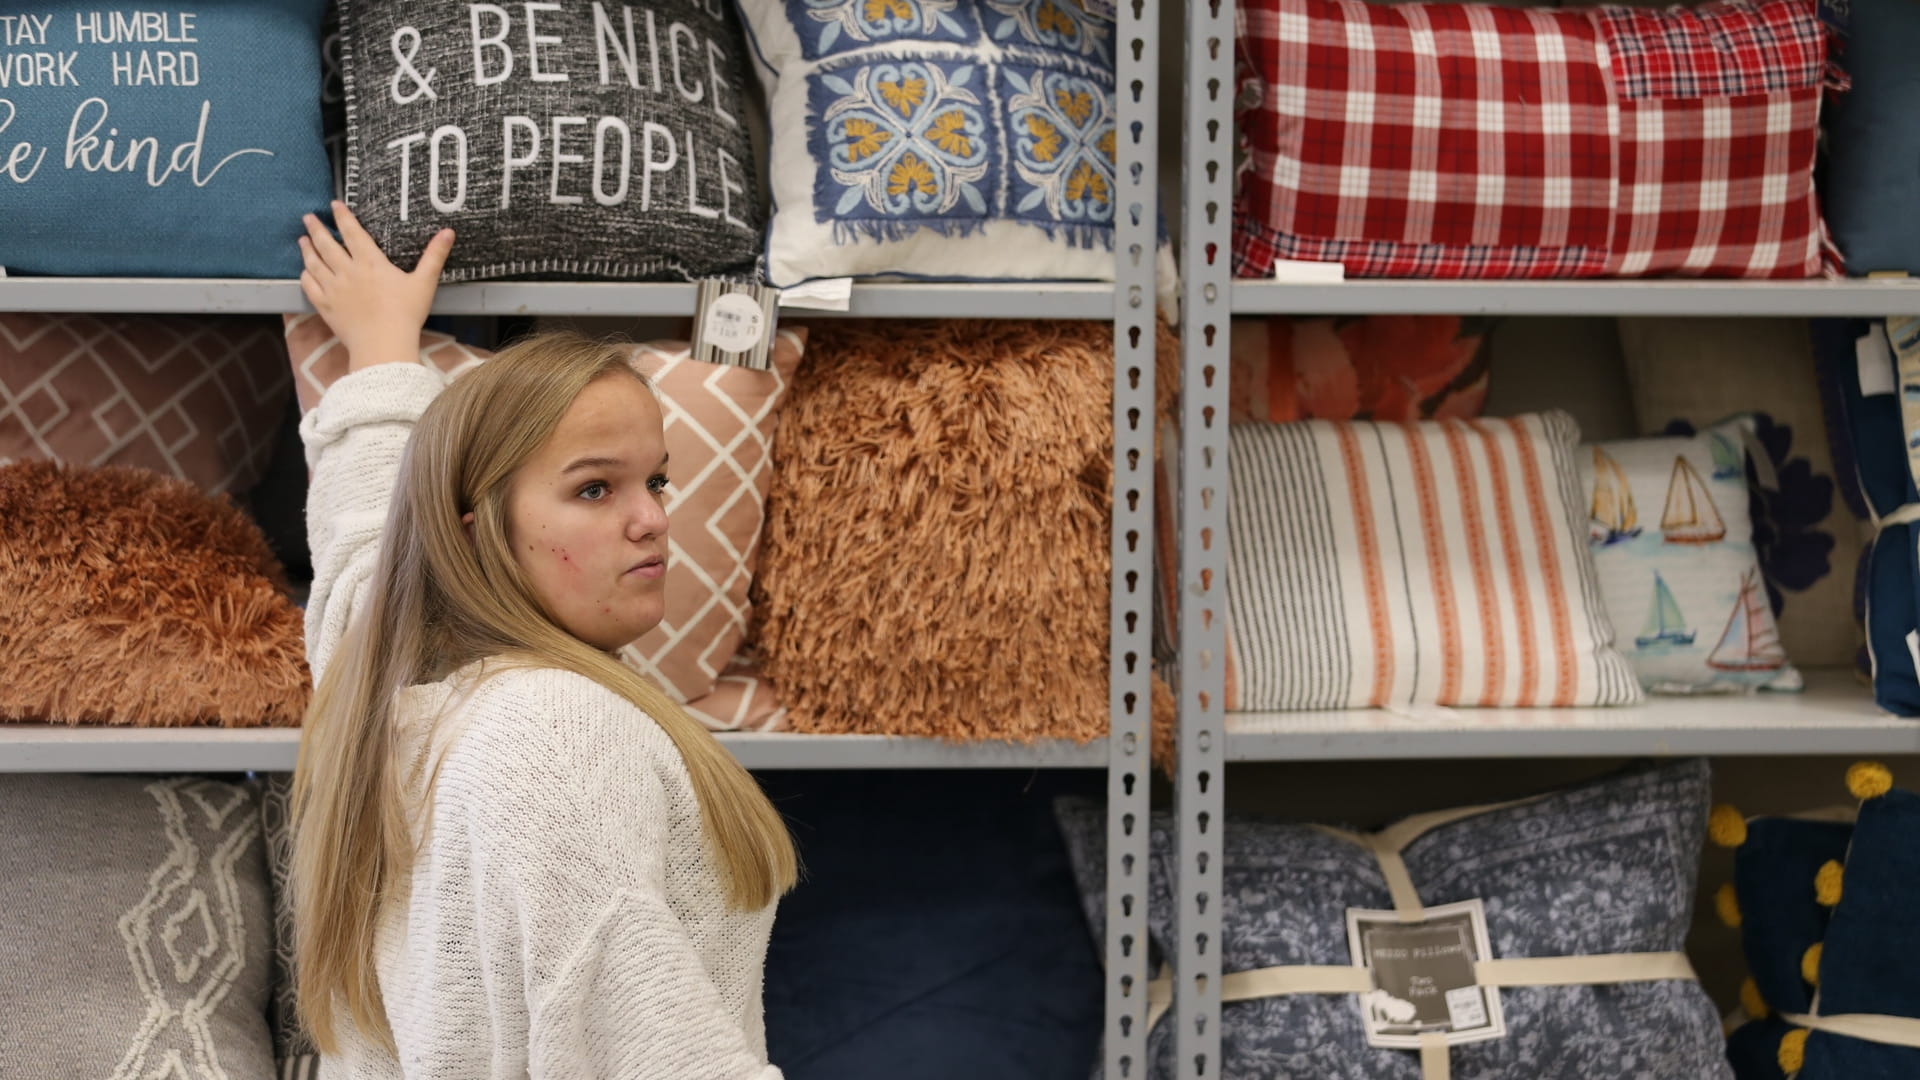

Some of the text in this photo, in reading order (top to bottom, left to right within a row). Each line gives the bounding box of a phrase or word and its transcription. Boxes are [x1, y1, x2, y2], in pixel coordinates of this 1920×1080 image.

[76, 11, 198, 44] HUMBLE
[112, 51, 200, 86] HARD
[390, 26, 438, 104] &
[469, 2, 569, 87] BE
[592, 3, 738, 127] NICE
[65, 97, 274, 187] kind
[387, 125, 468, 221] TO
[502, 116, 750, 229] PEOPLE
